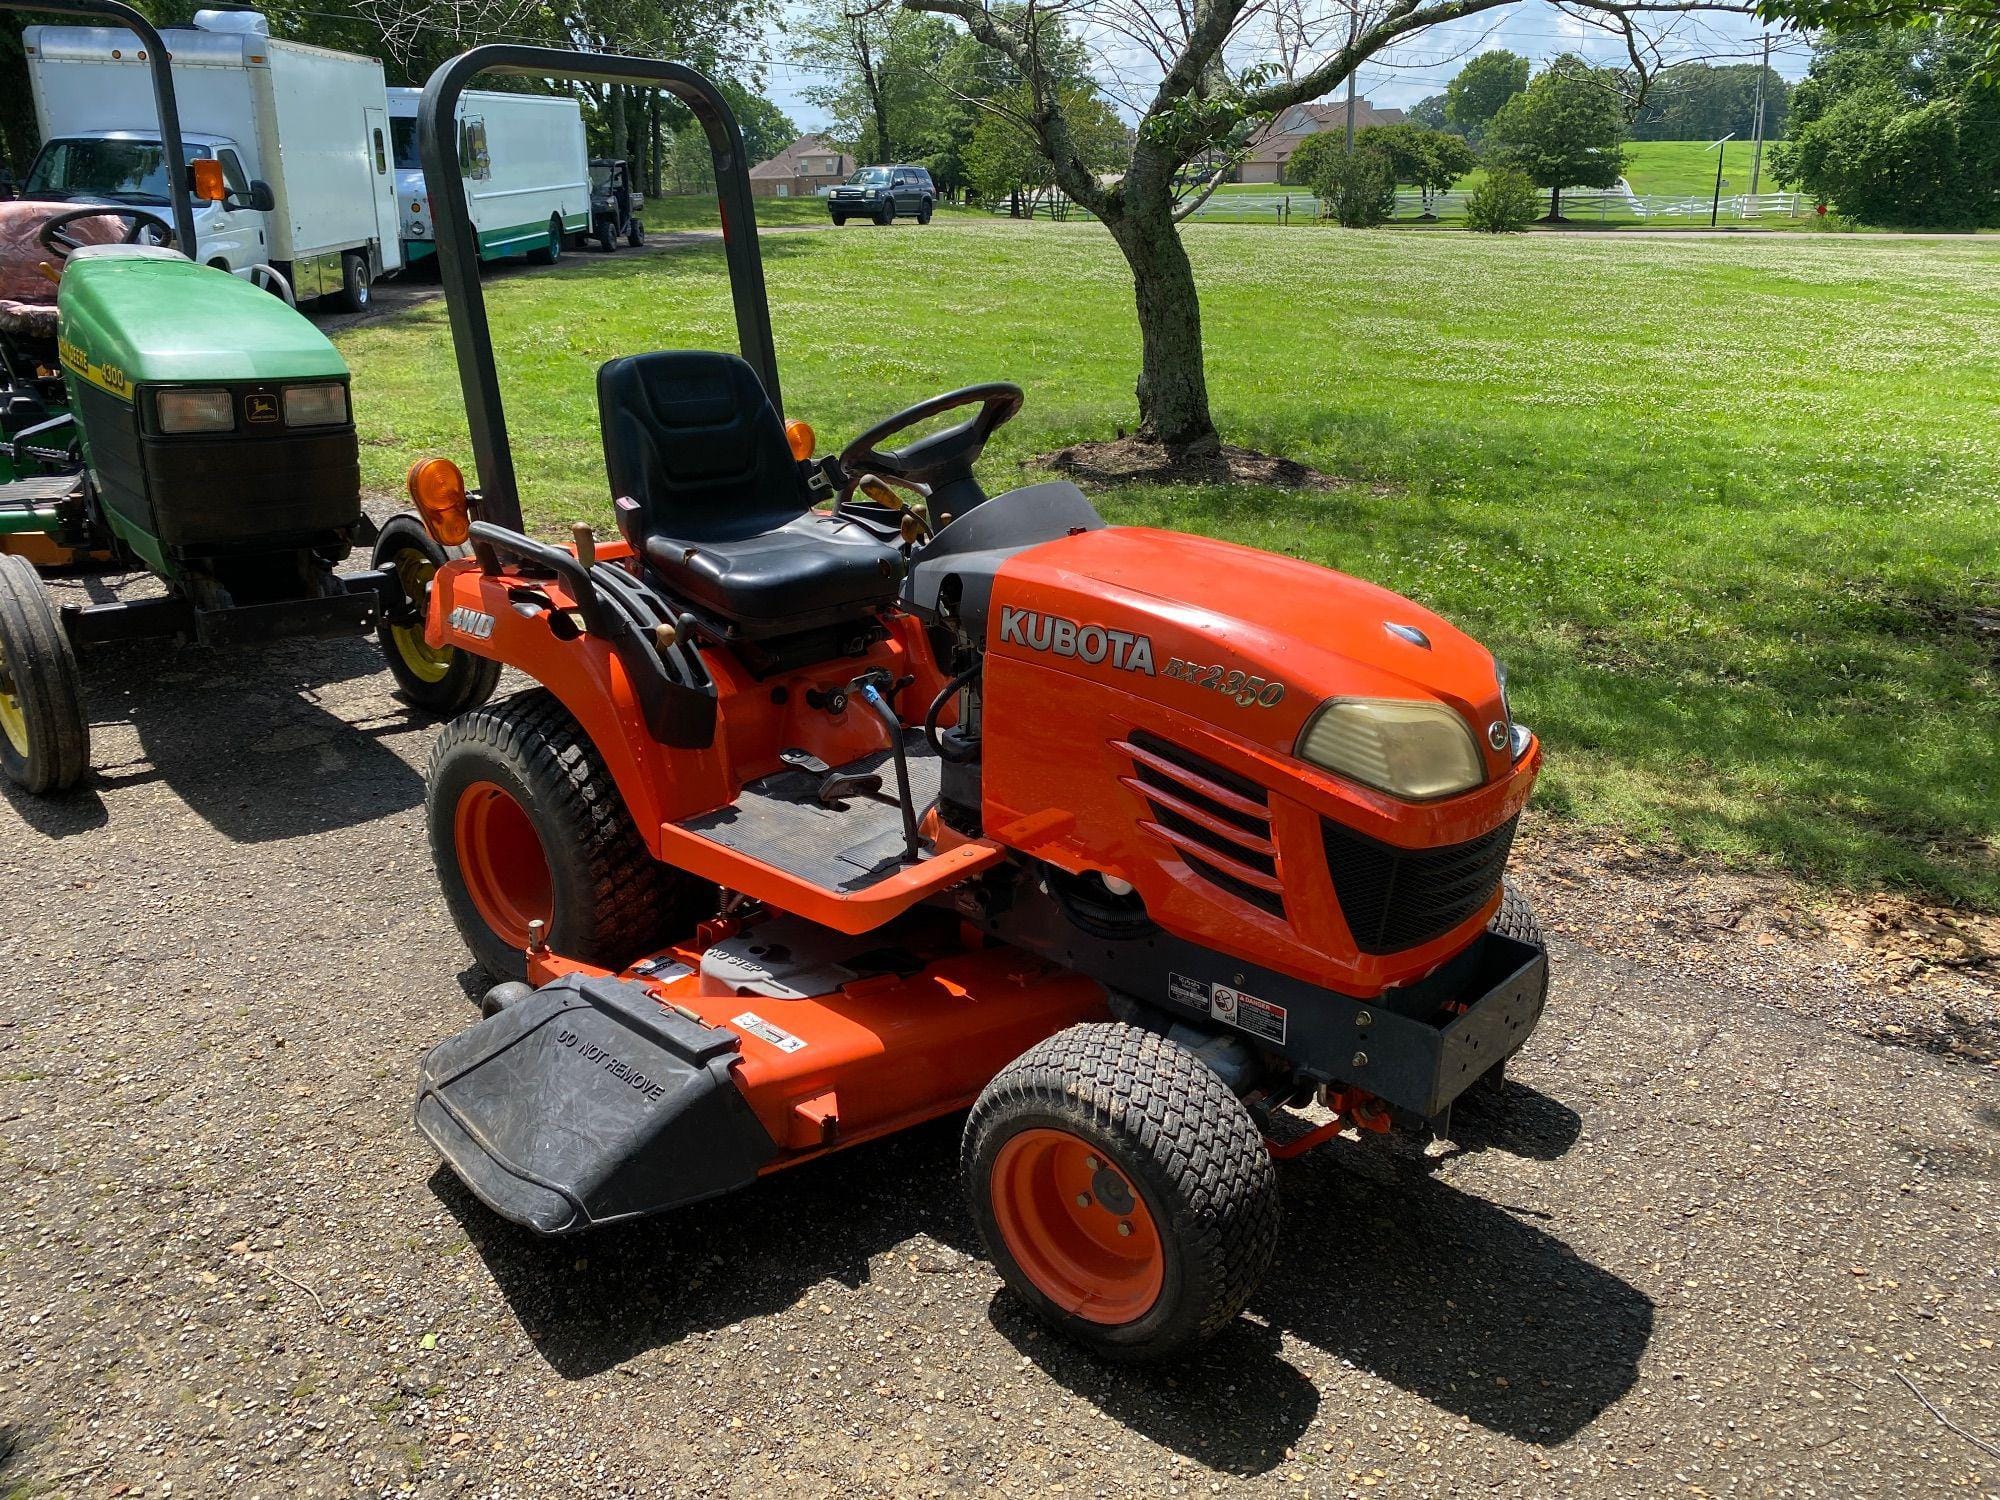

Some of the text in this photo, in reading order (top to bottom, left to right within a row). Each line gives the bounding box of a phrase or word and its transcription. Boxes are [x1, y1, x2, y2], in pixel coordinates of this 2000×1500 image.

[101, 363, 124, 387] 4300
[450, 606, 495, 638] 4WD
[1000, 606, 1157, 676] KUBOTA
[1161, 657, 1286, 708] BX2350
[707, 948, 764, 972] NO STEP
[1245, 997, 1270, 1010] DANGER
[556, 1030, 666, 1102] DO NOT REMOVE
